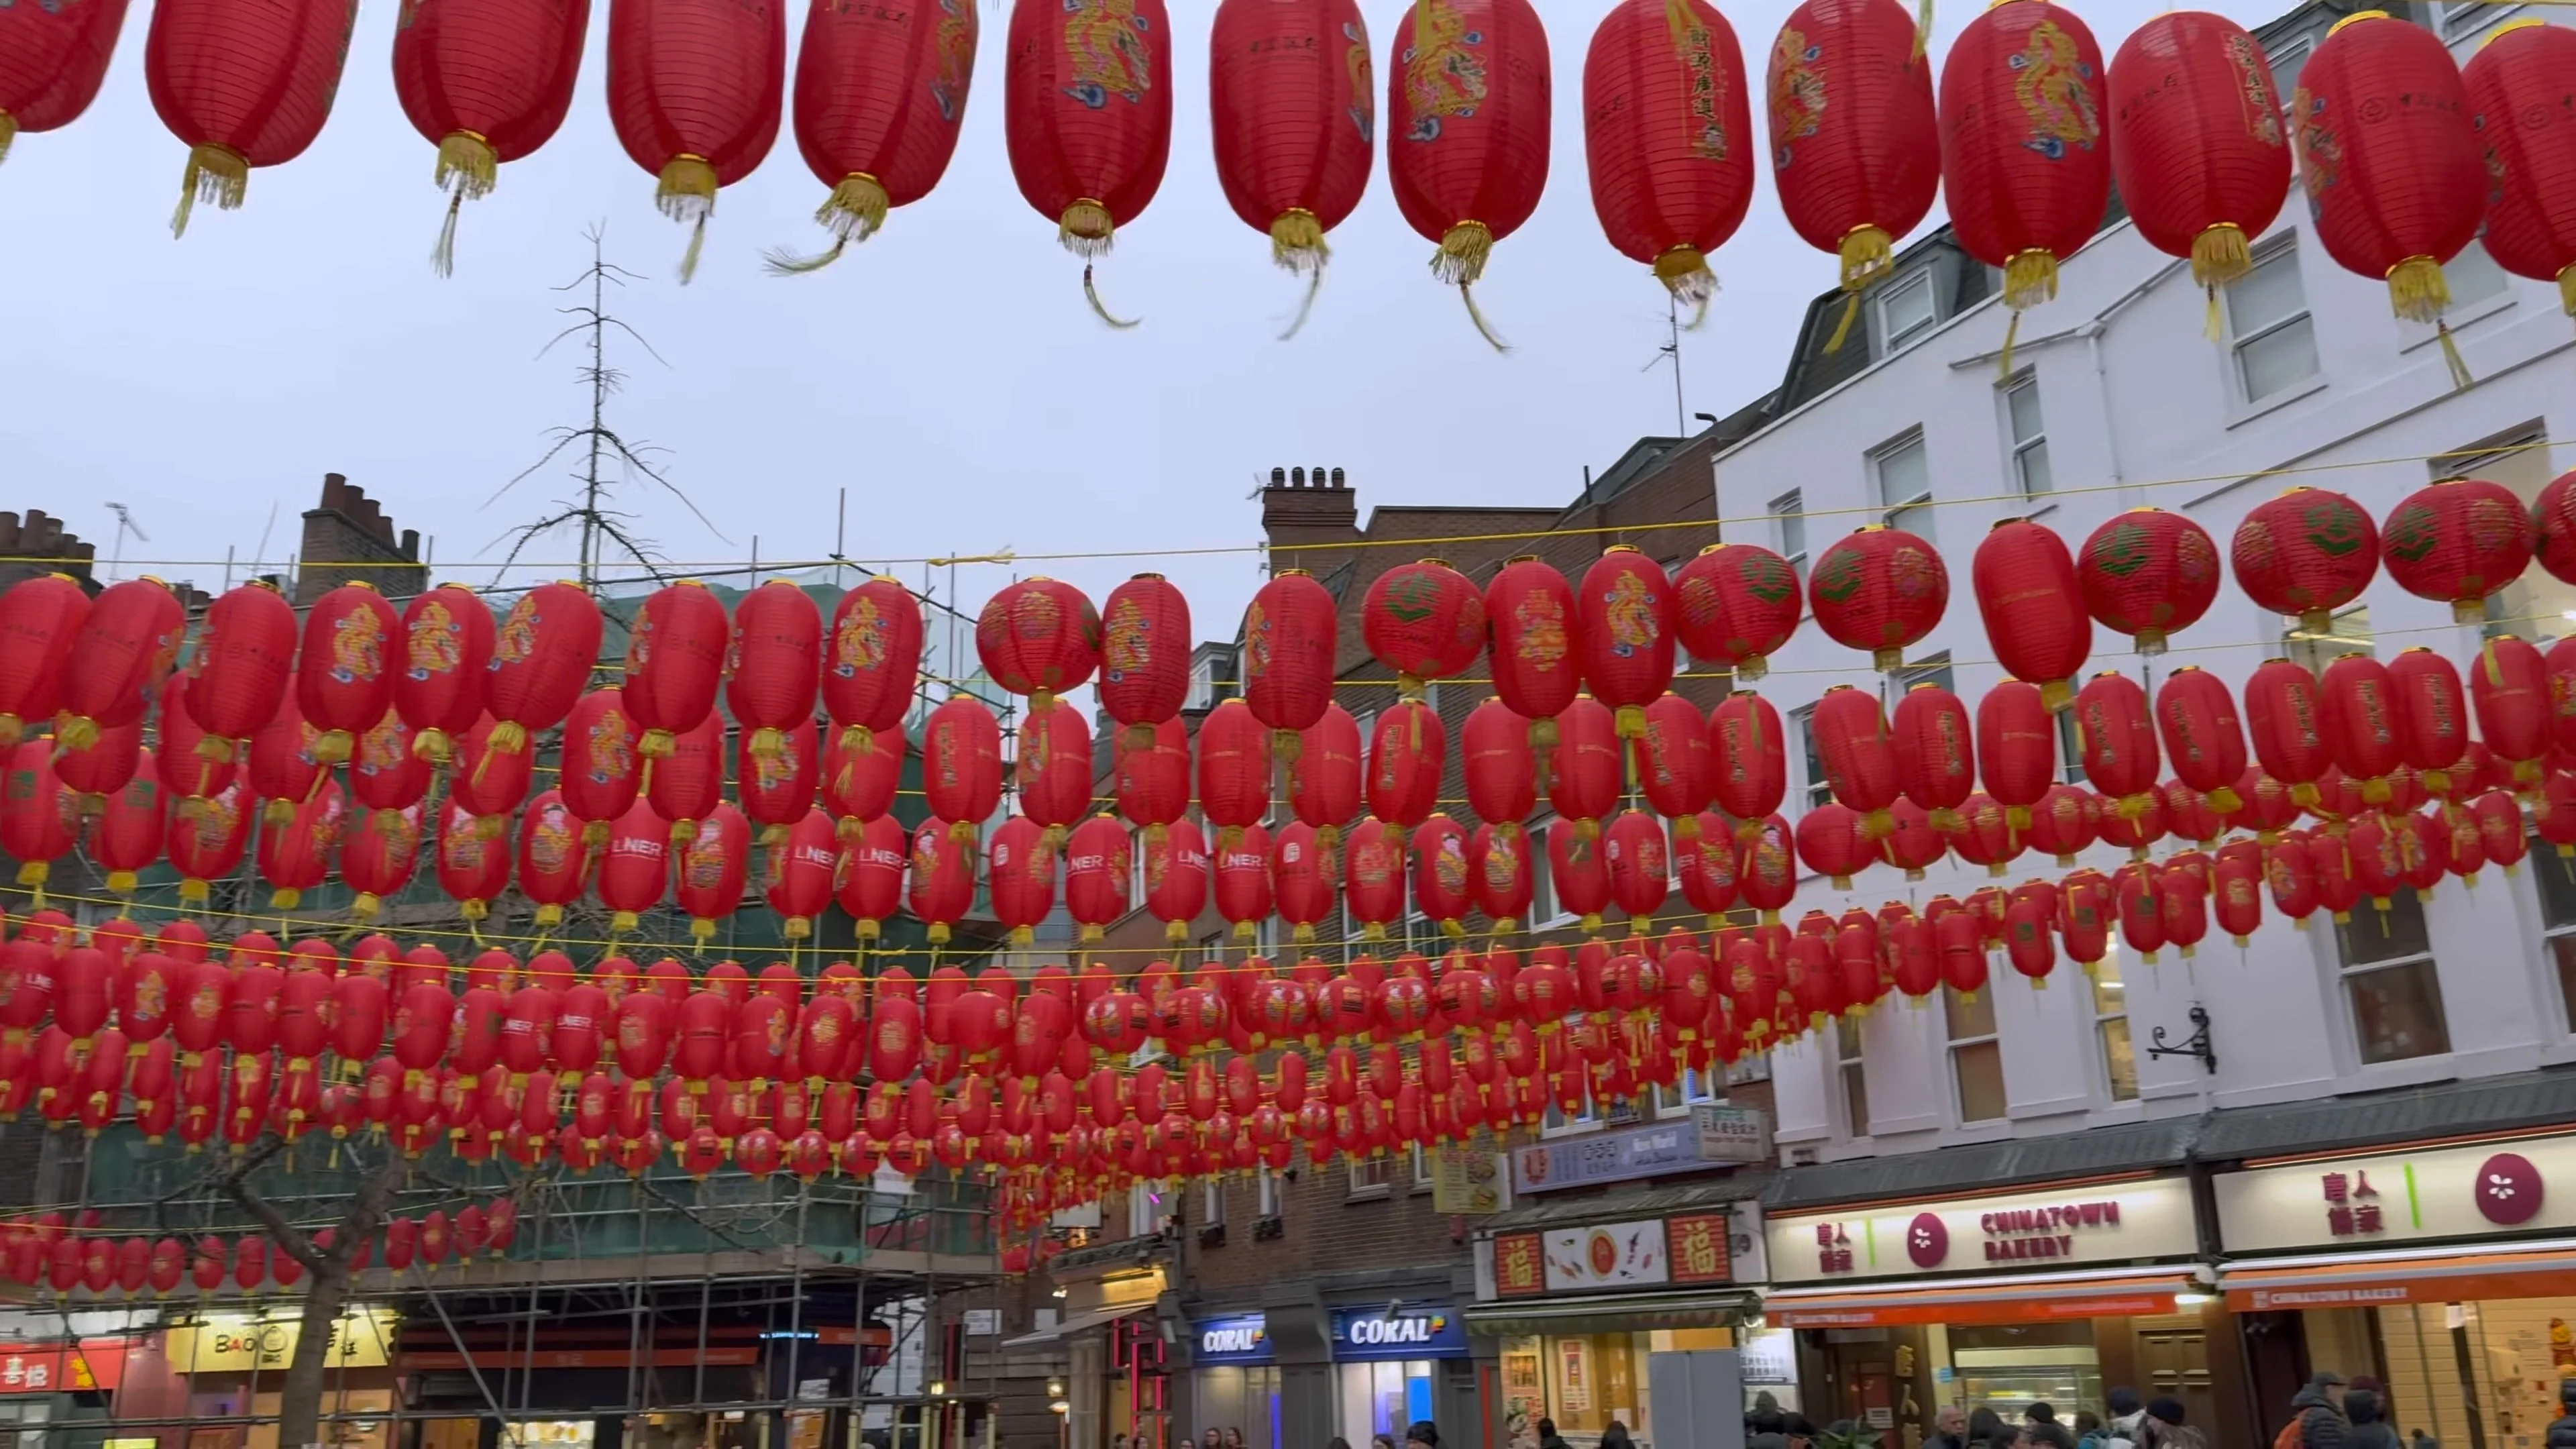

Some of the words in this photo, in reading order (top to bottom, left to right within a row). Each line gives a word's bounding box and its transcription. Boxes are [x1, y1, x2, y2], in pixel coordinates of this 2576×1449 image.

[611, 837, 662, 856] LNER
[1981, 1201, 2120, 1234] CHINATOWN
[1683, 1221, 1716, 1274] 福
[1984, 1235, 2072, 1261] BAKERY
[1505, 1239, 1533, 1287] 福
[1203, 1328, 1255, 1352] CORAL
